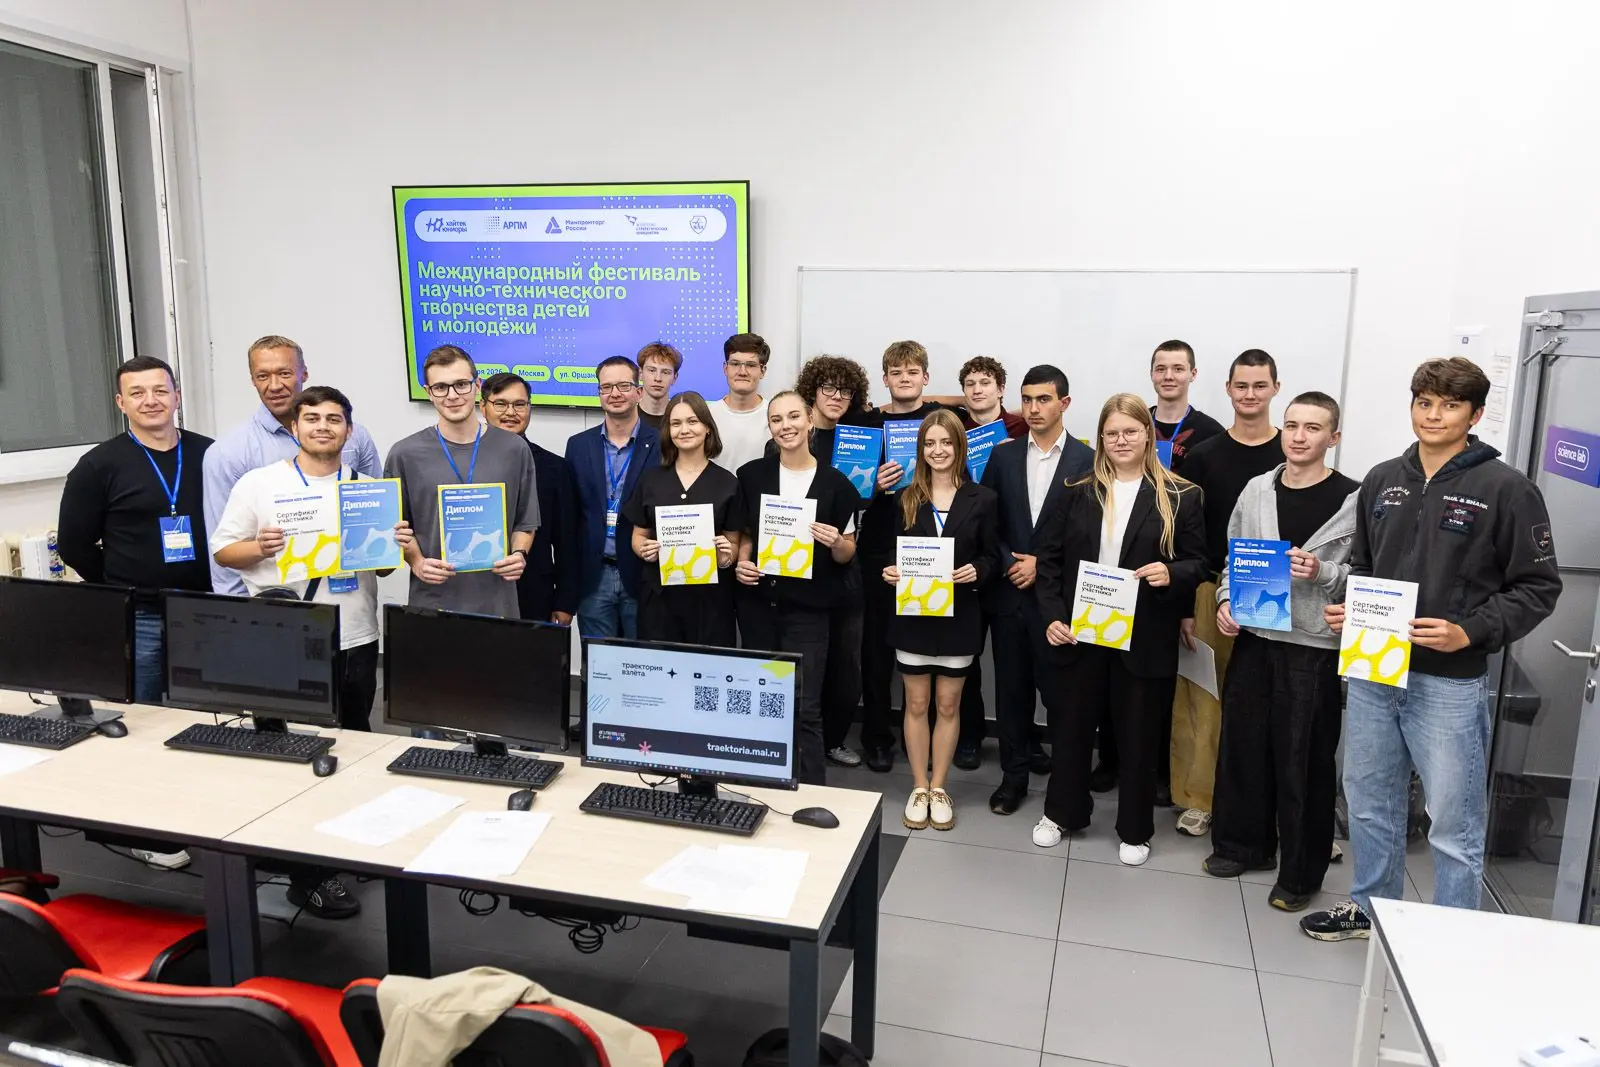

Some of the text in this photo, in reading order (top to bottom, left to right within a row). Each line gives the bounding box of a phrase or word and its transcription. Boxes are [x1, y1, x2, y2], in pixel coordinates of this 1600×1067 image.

[503, 221, 527, 230] АРПМ
[417, 261, 701, 284] Международный фестиваль
[419, 282, 627, 301] научно-технического
[420, 300, 590, 319] творчества детей
[422, 317, 537, 336] и молодёжи
[518, 369, 545, 377] Москва
[571, 371, 597, 379] Оршан
[838, 441, 866, 451] Диплом
[1557, 445, 1587, 463] science lab
[342, 500, 380, 511] Диплом
[446, 505, 484, 515] Диплом
[276, 509, 318, 519] Сертификат
[764, 513, 797, 522] Сертификат
[277, 516, 314, 524] участника
[1233, 557, 1269, 567] Диплом
[1082, 581, 1118, 593] Сертификат
[1082, 587, 1112, 596] участника
[1352, 600, 1395, 612] Сертификат
[1352, 607, 1389, 617] участника
[621, 662, 663, 672] траектория
[707, 742, 780, 758] traektoria.mai.ru
